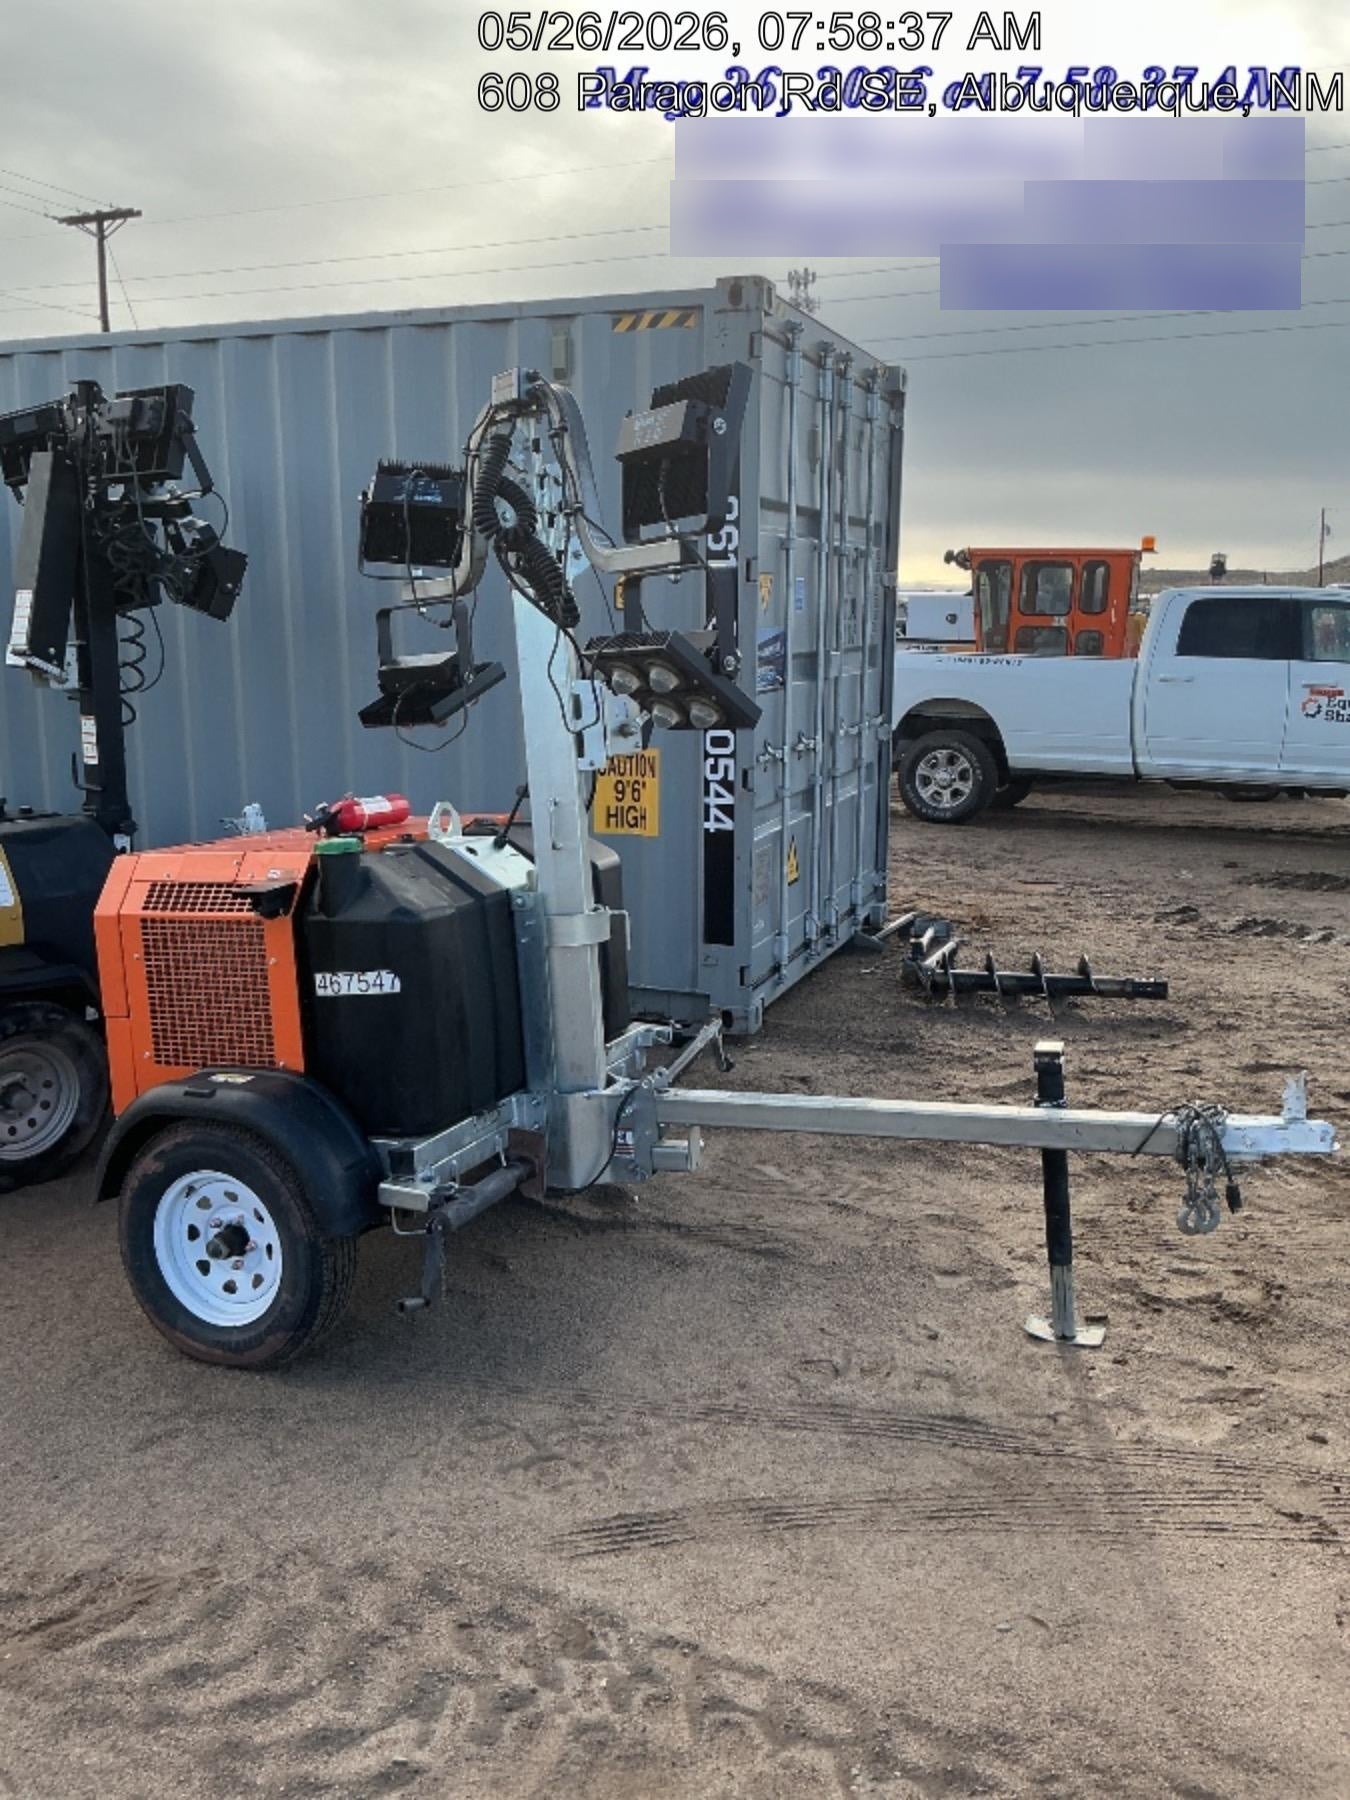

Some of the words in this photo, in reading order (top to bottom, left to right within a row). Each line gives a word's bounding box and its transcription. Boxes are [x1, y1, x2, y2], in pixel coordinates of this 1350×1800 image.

[703, 729, 736, 833] 0544
[605, 805, 647, 831] HIGH
[317, 970, 400, 995] 467547
